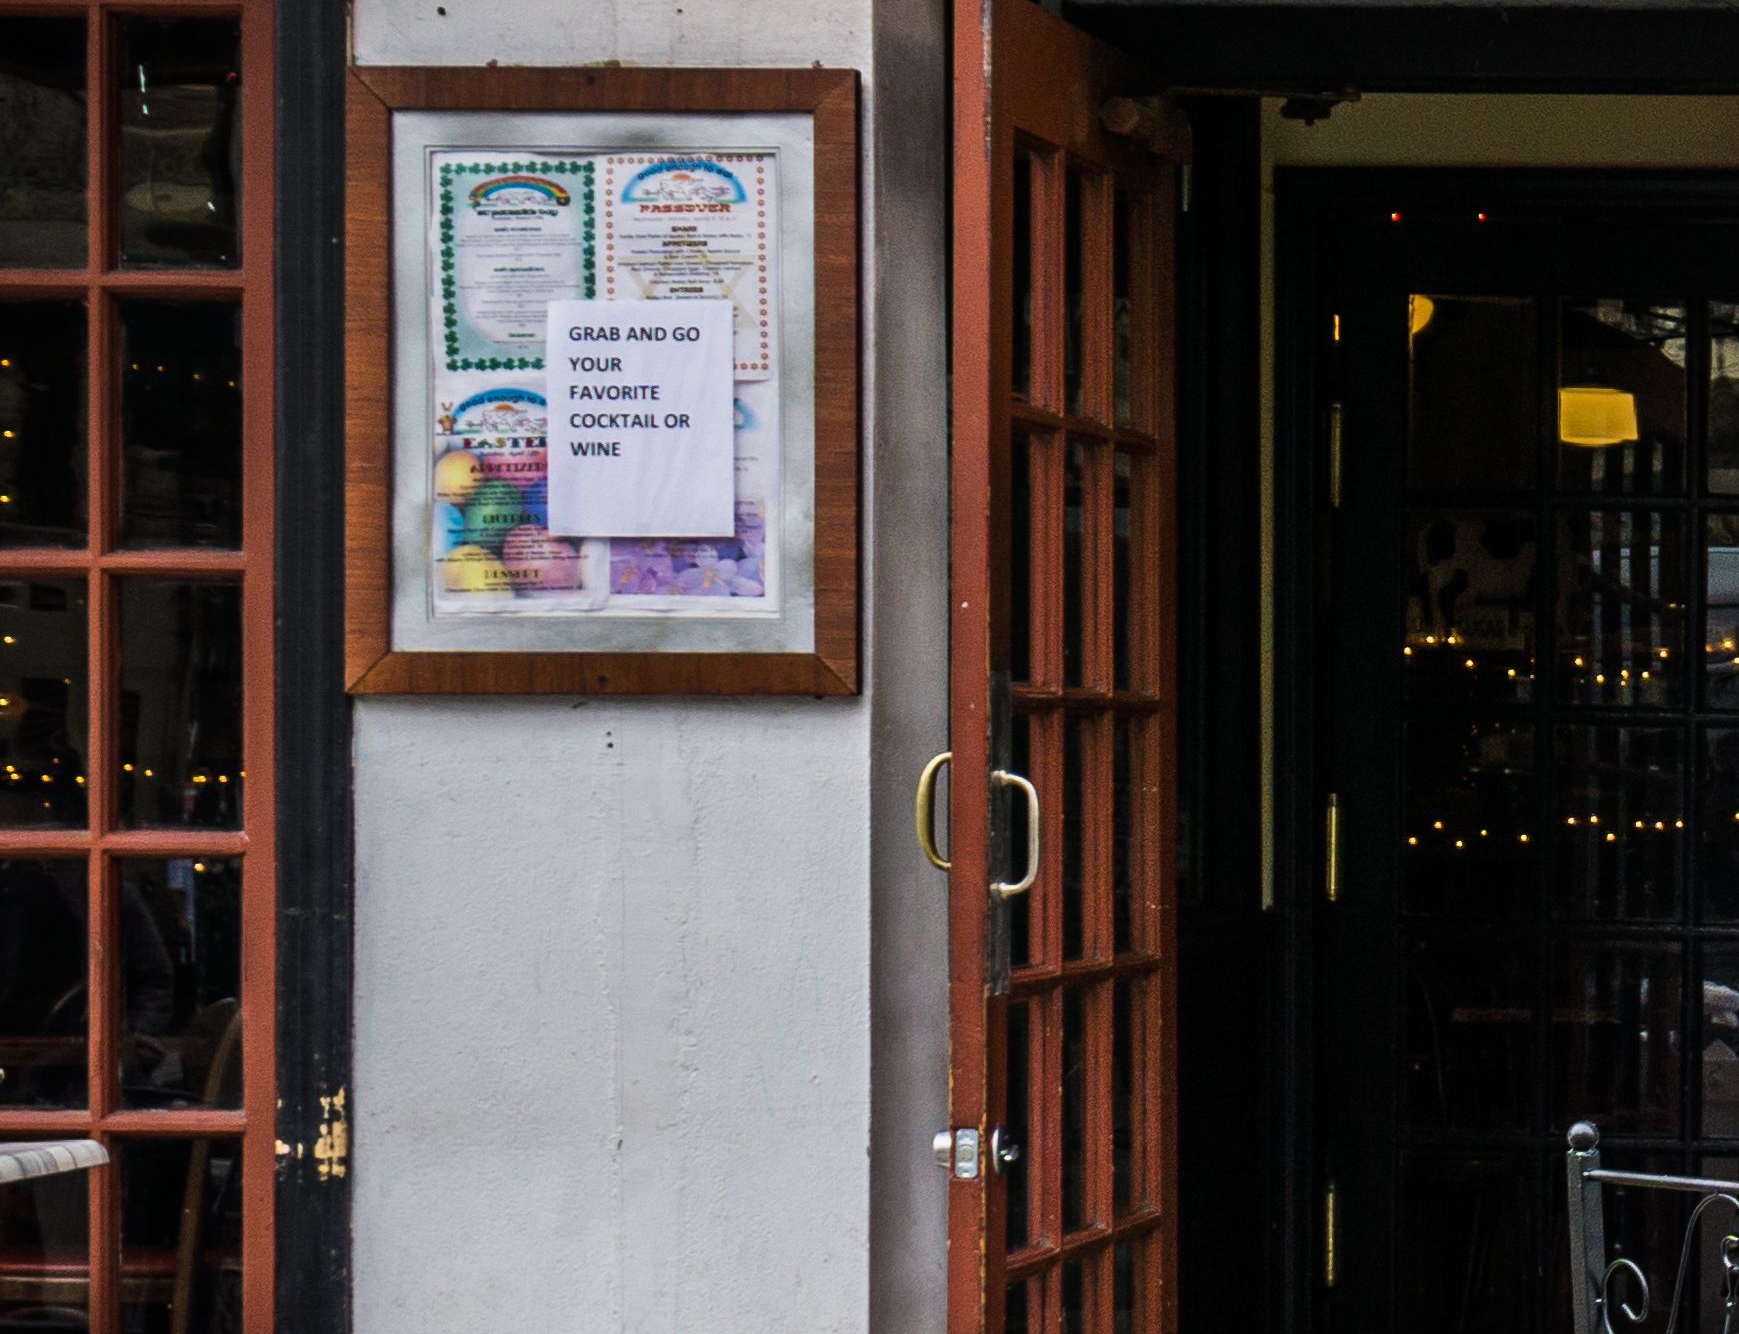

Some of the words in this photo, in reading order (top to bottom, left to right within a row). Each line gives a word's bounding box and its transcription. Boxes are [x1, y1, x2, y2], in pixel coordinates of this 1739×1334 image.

[640, 204, 731, 213] PASSOVER
[569, 327, 621, 341] GRAB
[626, 327, 667, 341] AND
[672, 327, 700, 341] GO
[569, 357, 622, 371] YOUR
[569, 385, 660, 400] FAVORITE
[570, 413, 659, 428] COCKTAIL
[664, 413, 691, 428] OR
[570, 442, 621, 456] WINE
